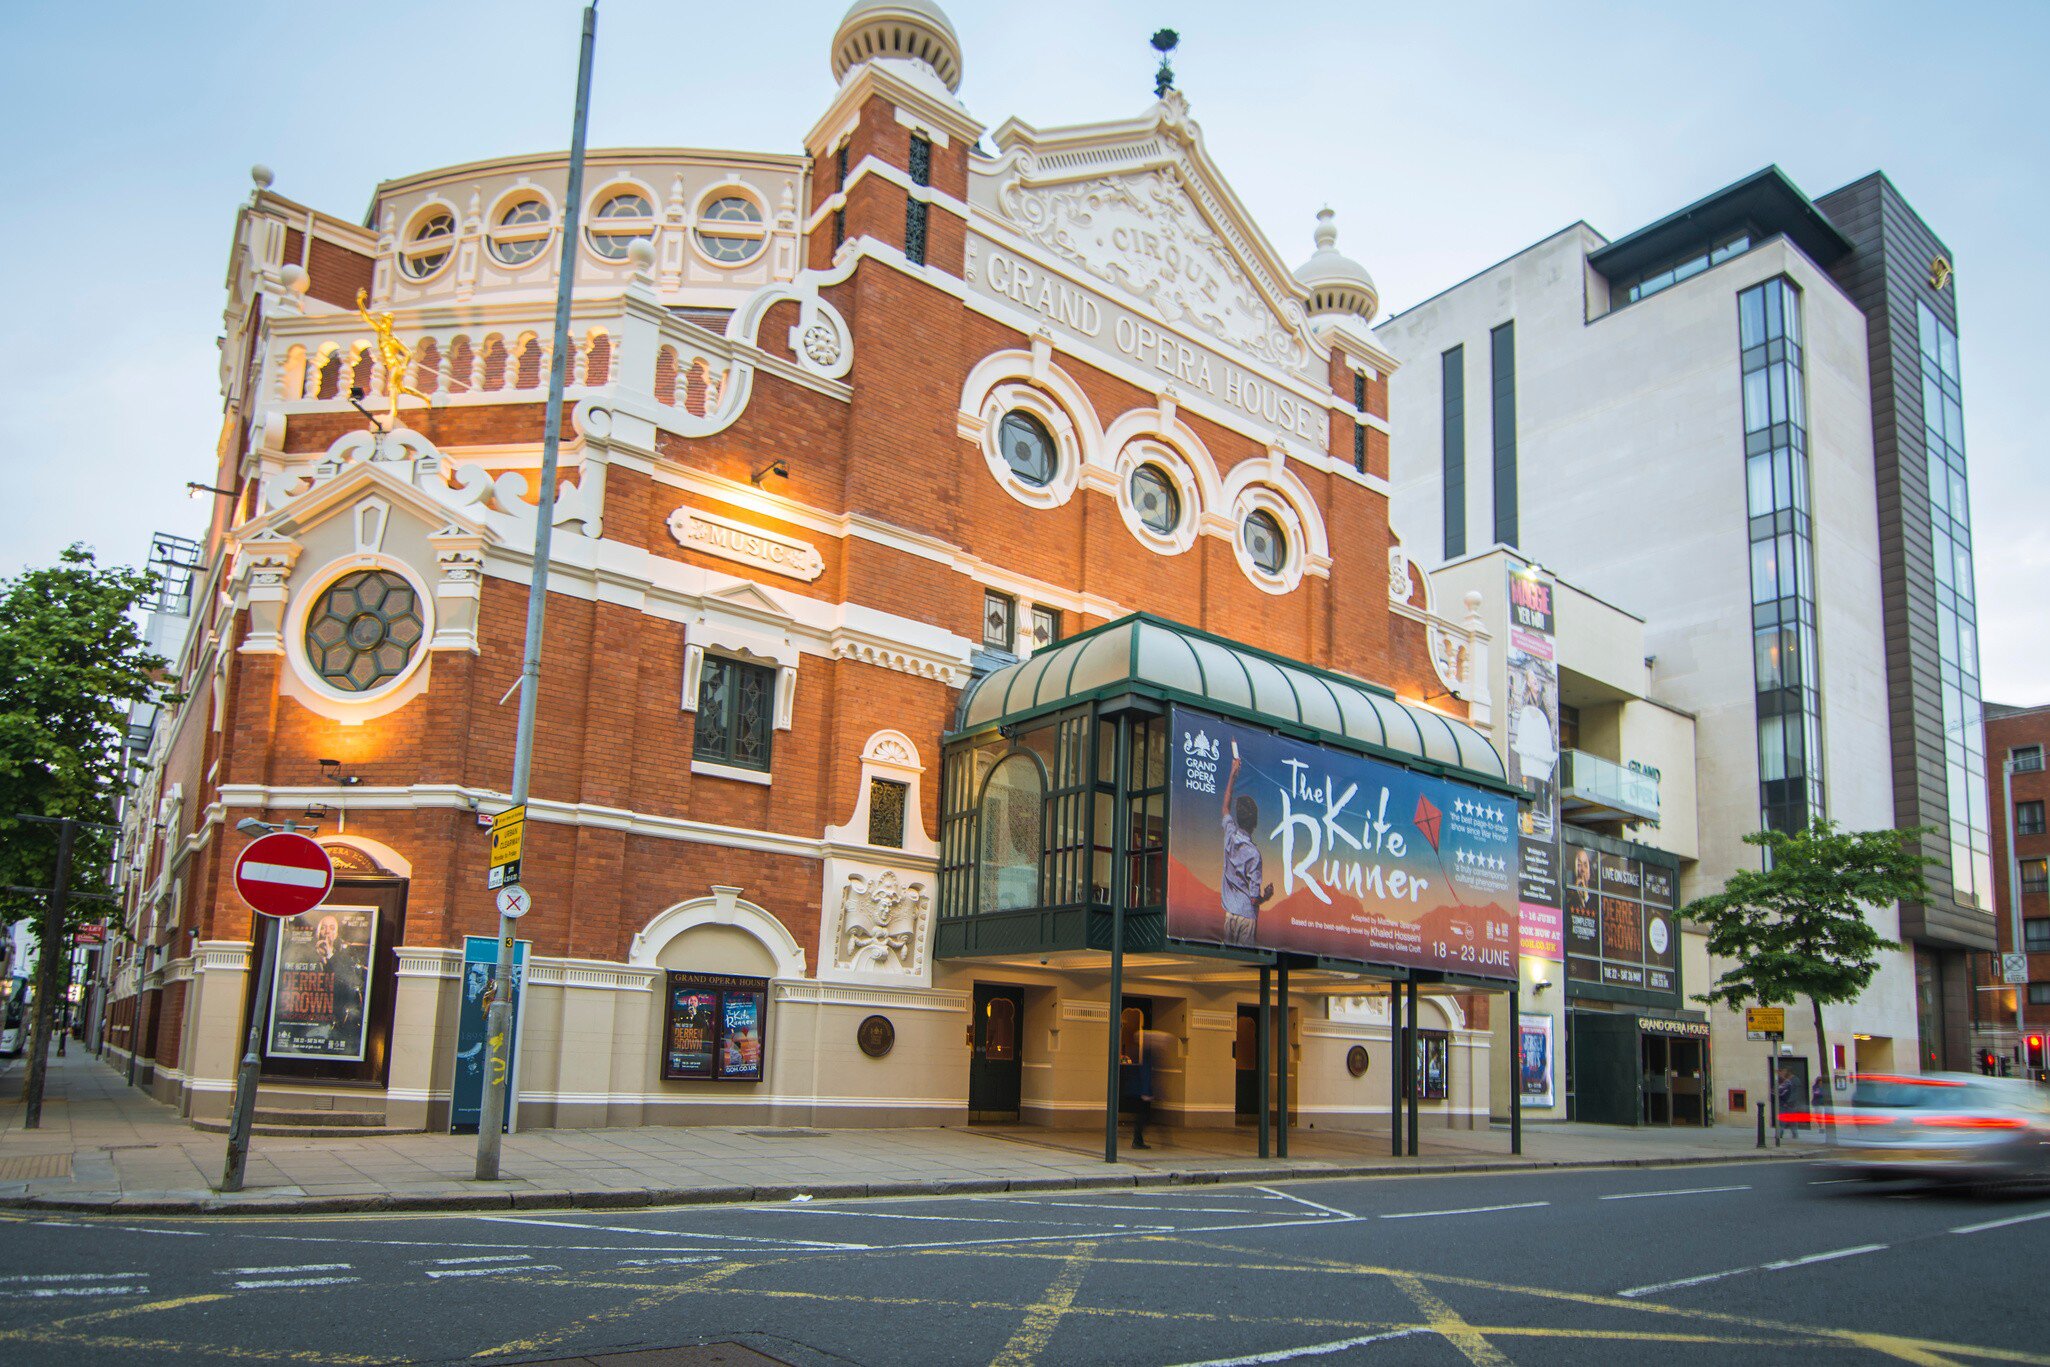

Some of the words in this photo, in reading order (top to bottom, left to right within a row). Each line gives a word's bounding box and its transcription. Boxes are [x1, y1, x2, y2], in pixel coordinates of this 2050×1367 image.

[1112, 226, 1219, 303] CIRQUE
[987, 252, 1102, 337] GRAND
[1115, 315, 1215, 396] OPERA
[1223, 367, 1313, 441] HOUSE
[710, 525, 784, 562] MUSIC
[1185, 757, 1217, 773] GRAND
[1187, 768, 1216, 785] OPERA
[1281, 757, 1324, 804] The
[1185, 779, 1216, 794] HOUSE
[1322, 774, 1408, 858] Kite
[503, 826, 519, 839] URBAN
[500, 837, 521, 850] CLEARWAY
[1270, 788, 1429, 905] Runner
[1602, 866, 1614, 881] LIVE
[1614, 868, 1623, 883] ON
[1622, 871, 1640, 887] STAGE
[1602, 896, 1641, 923] DERREN
[1291, 917, 1307, 926] Based
[1315, 921, 1323, 930] the
[1370, 927, 1394, 939] Khaled
[1518, 925, 1534, 936] OOK
[506, 938, 513, 948] 3
[1433, 940, 1447, 959] 18
[1461, 944, 1475, 962] 23
[1478, 947, 1510, 968] JUNE
[295, 962, 309, 971] BEST
[310, 962, 318, 971] OF
[282, 971, 335, 992] DERREN
[675, 973, 707, 984] GRAND
[709, 976, 736, 985] OPERA
[740, 978, 766, 987] HOUSE
[280, 991, 335, 1014] BROWN
[725, 1014, 755, 1028] Runner
[733, 1009, 751, 1021] Kite
[674, 1028, 703, 1039] DERREN
[1639, 1017, 1664, 1032] GRAND
[1664, 1020, 1687, 1035] OPERA
[1687, 1022, 1709, 1035] HOUSE
[673, 1038, 703, 1050] BROWN
